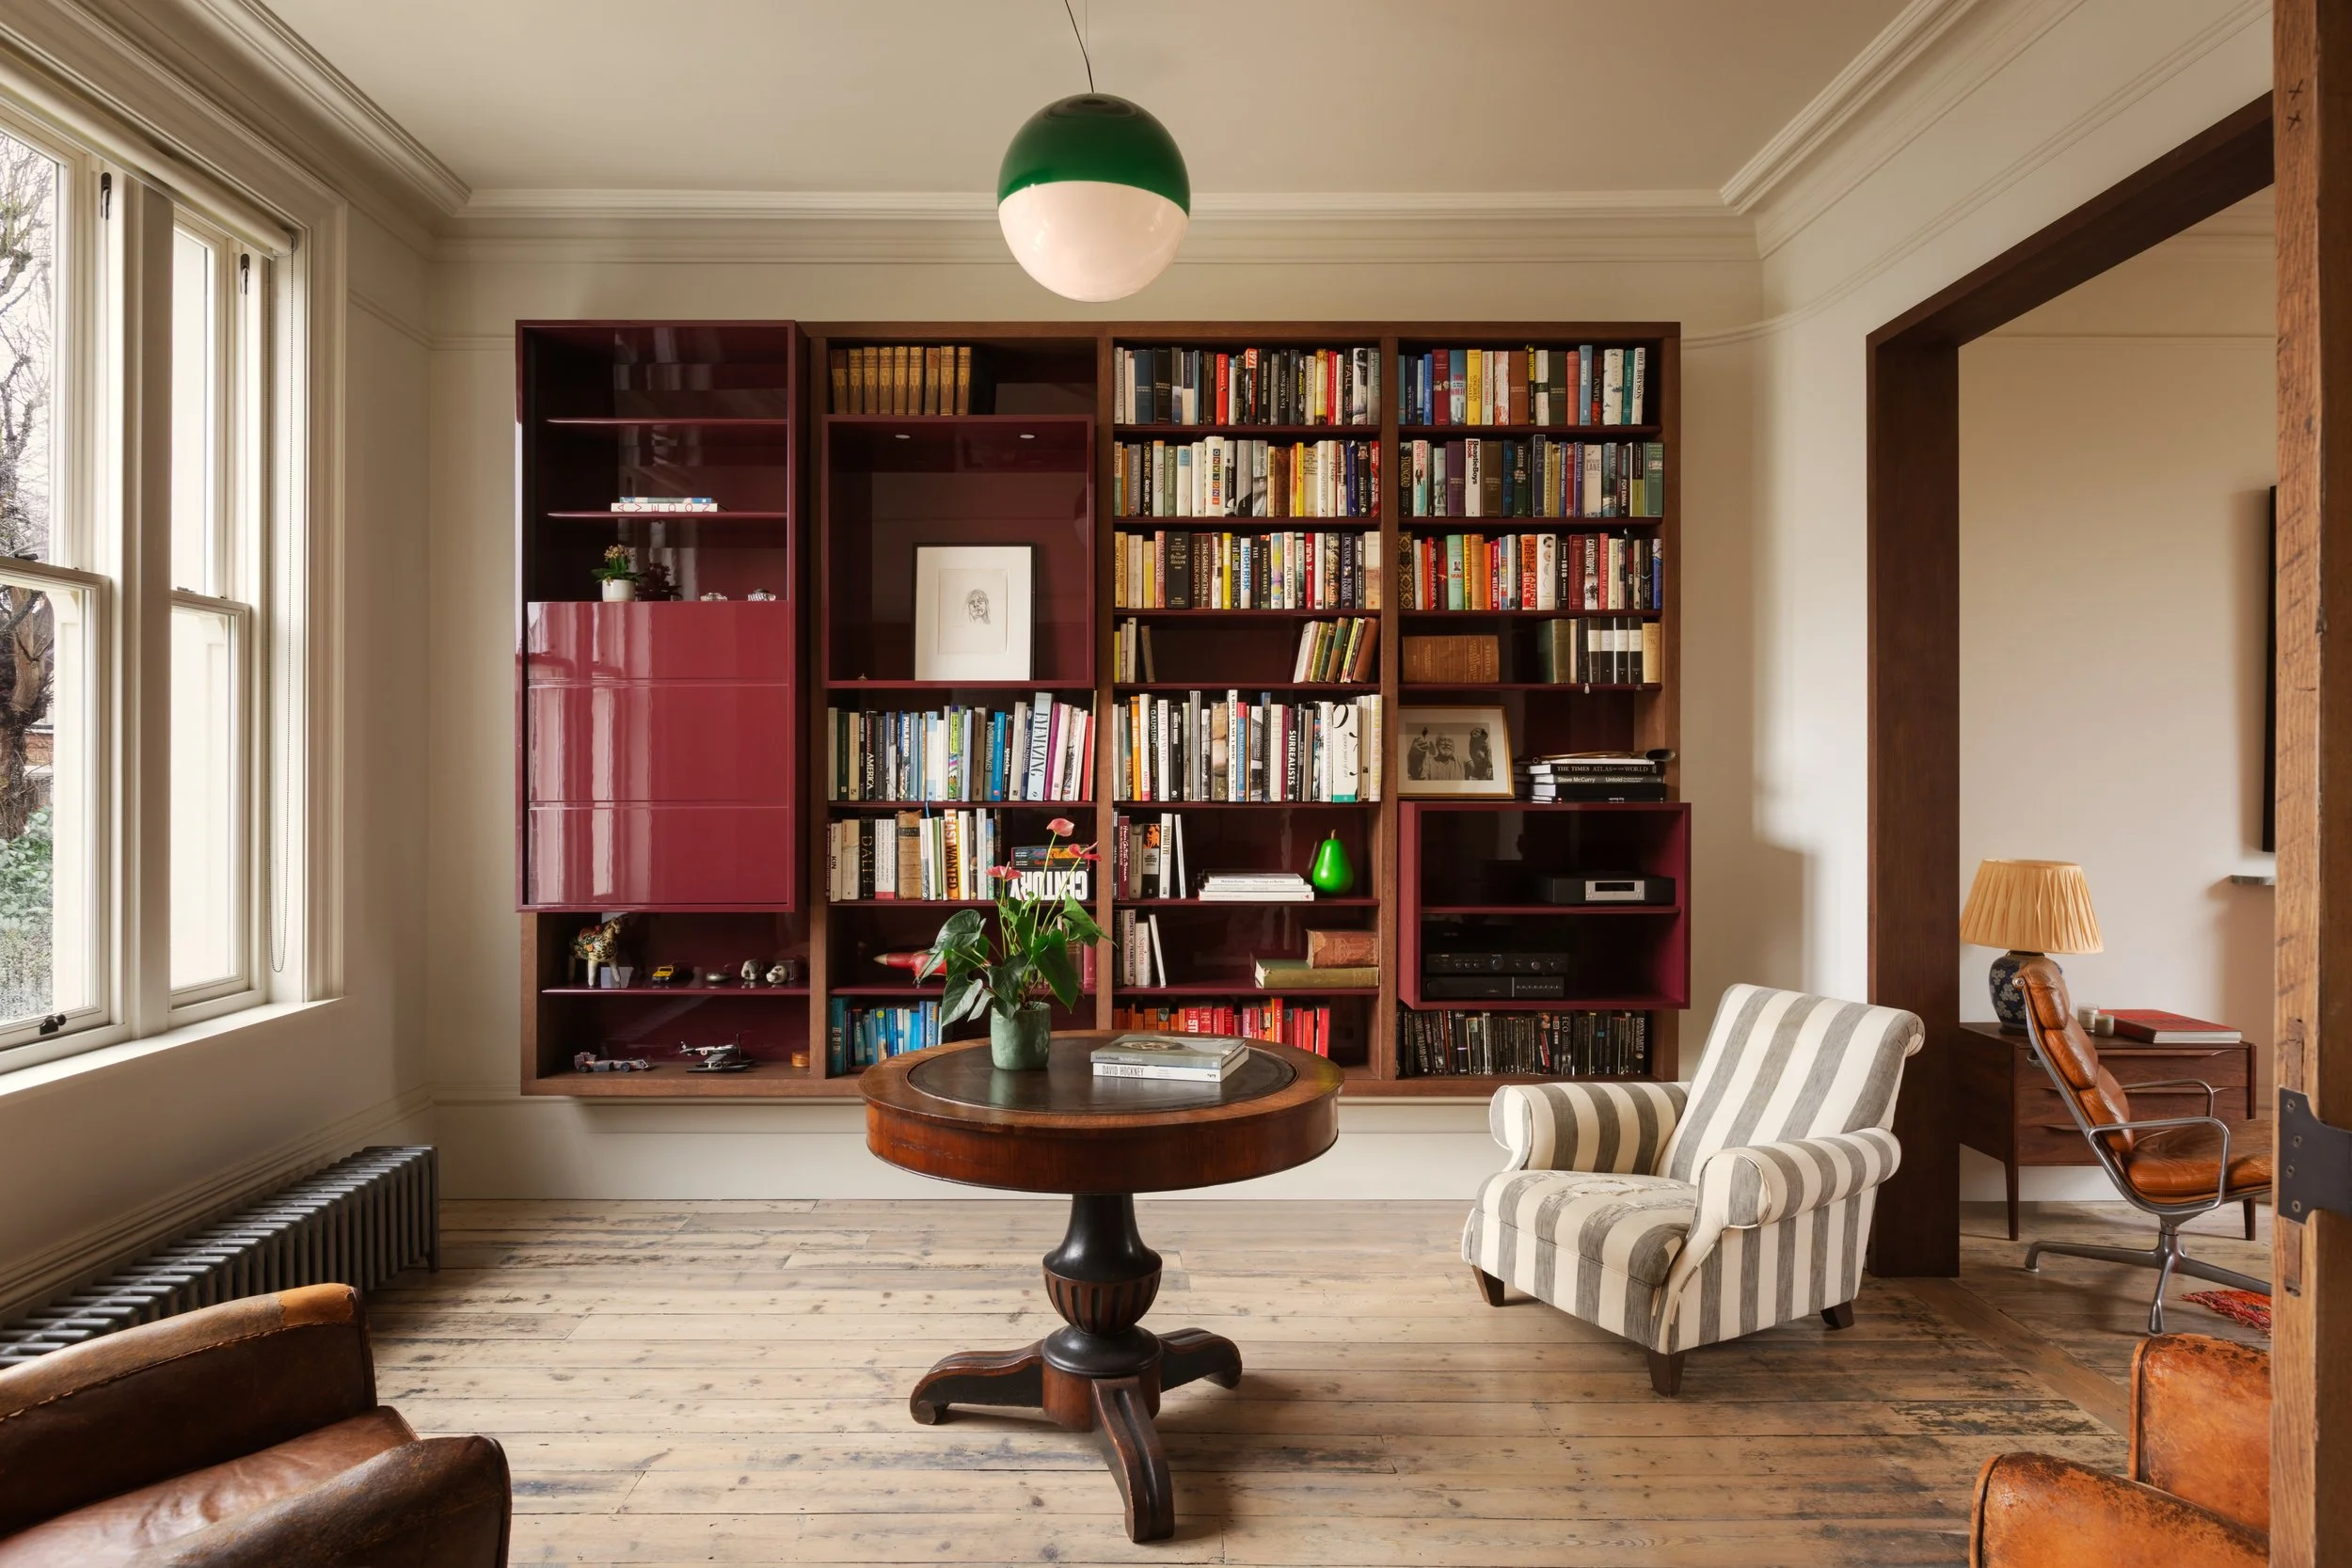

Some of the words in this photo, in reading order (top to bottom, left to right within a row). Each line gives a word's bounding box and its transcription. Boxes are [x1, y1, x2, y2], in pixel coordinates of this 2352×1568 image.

[1248, 350, 1257, 369] 1971
[1402, 457, 1411, 488] STALINGRAD
[617, 504, 710, 512] AVEDON
[1585, 539, 1594, 574] CATASTROPHE
[986, 722, 995, 747] NOAH
[1030, 712, 1049, 777] EYEMAZING
[986, 748, 995, 772] DAVIS
[945, 810, 957, 844] LEAST
[946, 844, 958, 889] WANTED
[1009, 871, 1088, 901] CENTURY
[1138, 937, 1146, 964] Sapiens
[1102, 1066, 1117, 1076] DAVID
[1120, 1066, 1144, 1076] HOCKNEY
